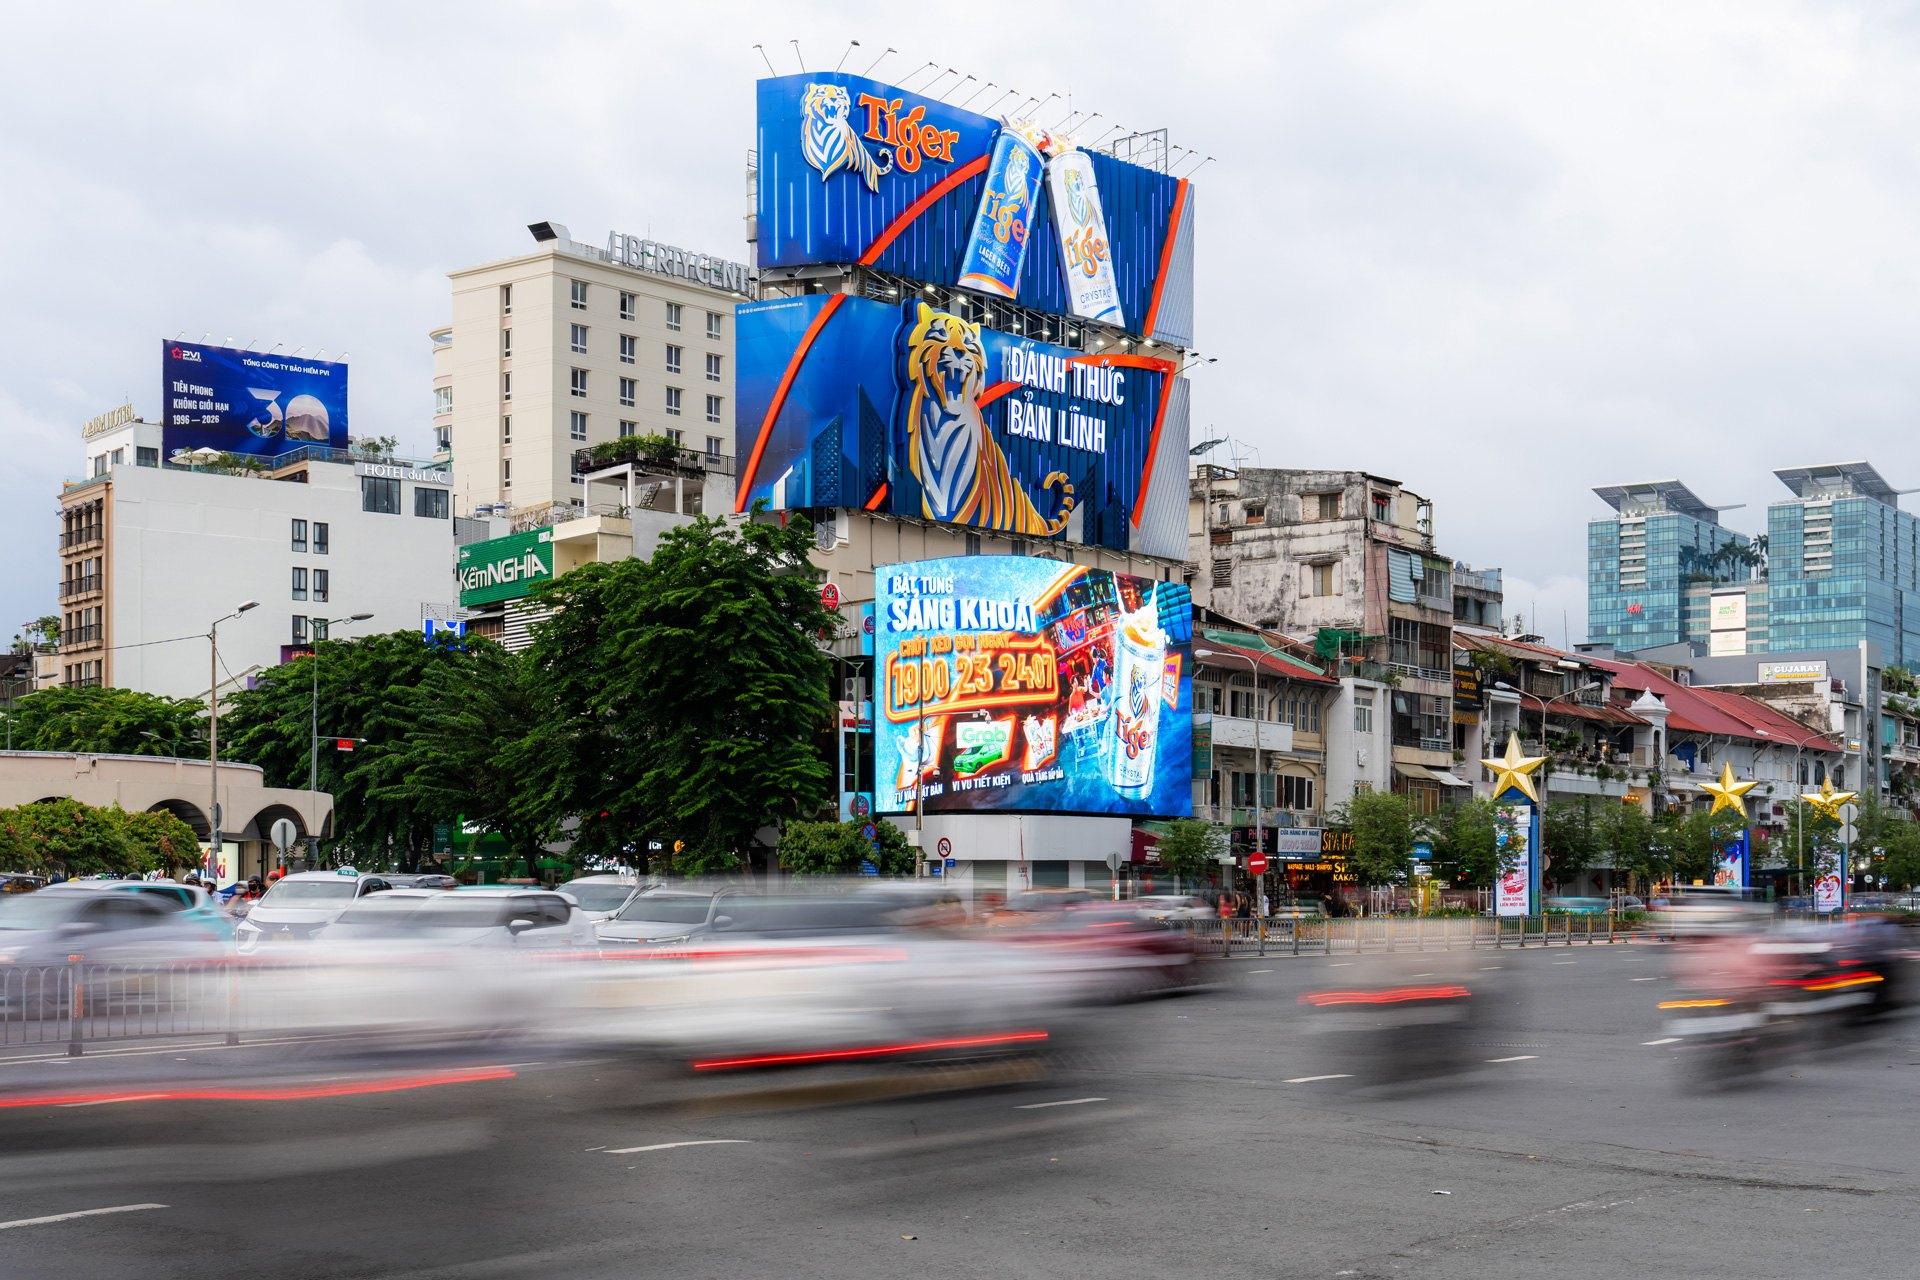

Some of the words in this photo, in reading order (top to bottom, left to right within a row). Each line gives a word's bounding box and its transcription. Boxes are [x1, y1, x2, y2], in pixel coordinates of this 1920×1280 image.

[859, 92, 959, 173] Tiger
[611, 230, 693, 278] LIBERTY
[695, 254, 750, 293] CENT
[979, 245, 996, 263] LAGER
[996, 257, 1010, 275] BEER
[183, 350, 200, 359] PVI
[243, 359, 260, 368] TỔNG
[261, 361, 279, 370] CÔNG
[280, 363, 288, 371] TY
[290, 363, 302, 373] BẢO
[303, 365, 318, 375] HIỂM
[1008, 341, 1066, 394] ĐÁNH
[1070, 359, 1125, 406] THỨC
[173, 380, 188, 393] TIÊN
[190, 384, 214, 397] PHONG
[173, 397, 198, 410] KHÔNG
[199, 400, 214, 411] GIỚI
[215, 402, 229, 413] HẠN
[173, 415, 190, 425] 1996
[202, 415, 220, 424] 2026
[1007, 390, 1051, 442] BẢN
[1058, 405, 1106, 454] LĨNH
[364, 464, 406, 479] HOTEL
[408, 469, 421, 480] du
[890, 573, 919, 596] BẬT
[921, 576, 953, 594] TUNG
[958, 597, 1036, 632] KHOÁI
[1774, 665, 1821, 673] GUJARAT
[892, 658, 950, 707] 1900
[956, 654, 994, 694] 23
[998, 652, 1053, 690] 2407
[961, 727, 1007, 744] Grab
[952, 780, 961, 792] VI
[962, 778, 973, 790] VU
[974, 774, 991, 789] TIẾT
[992, 774, 1011, 788] KIỆM
[1022, 772, 1035, 784] QUÀ
[930, 782, 943, 796] BÀN
